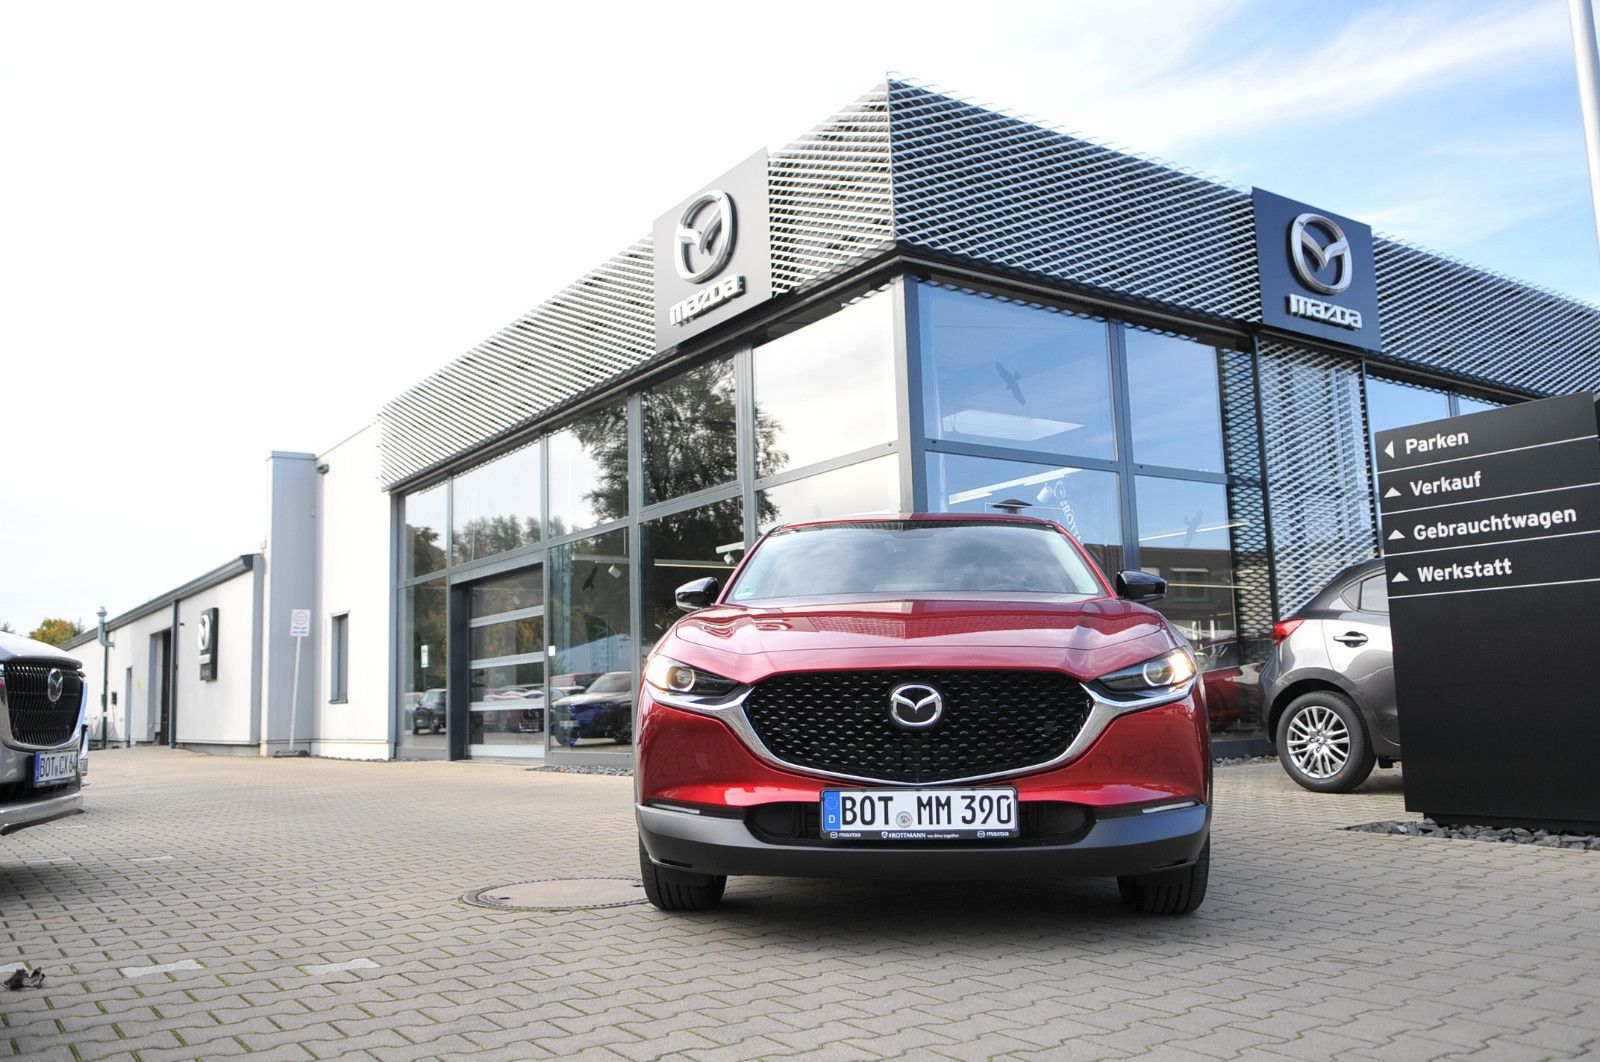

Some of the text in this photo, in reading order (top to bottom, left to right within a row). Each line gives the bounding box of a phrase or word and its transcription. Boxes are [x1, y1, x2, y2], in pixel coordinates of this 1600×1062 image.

[1405, 432, 1469, 455] Parken
[1409, 471, 1482, 497] Verkauf
[1413, 508, 1577, 541] Gebrauchtwagen
[1417, 558, 1512, 583] Werkstatt
[40, 756, 55, 777] BOT
[59, 755, 69, 775] CX
[828, 794, 1012, 826] D BOT MM 390
